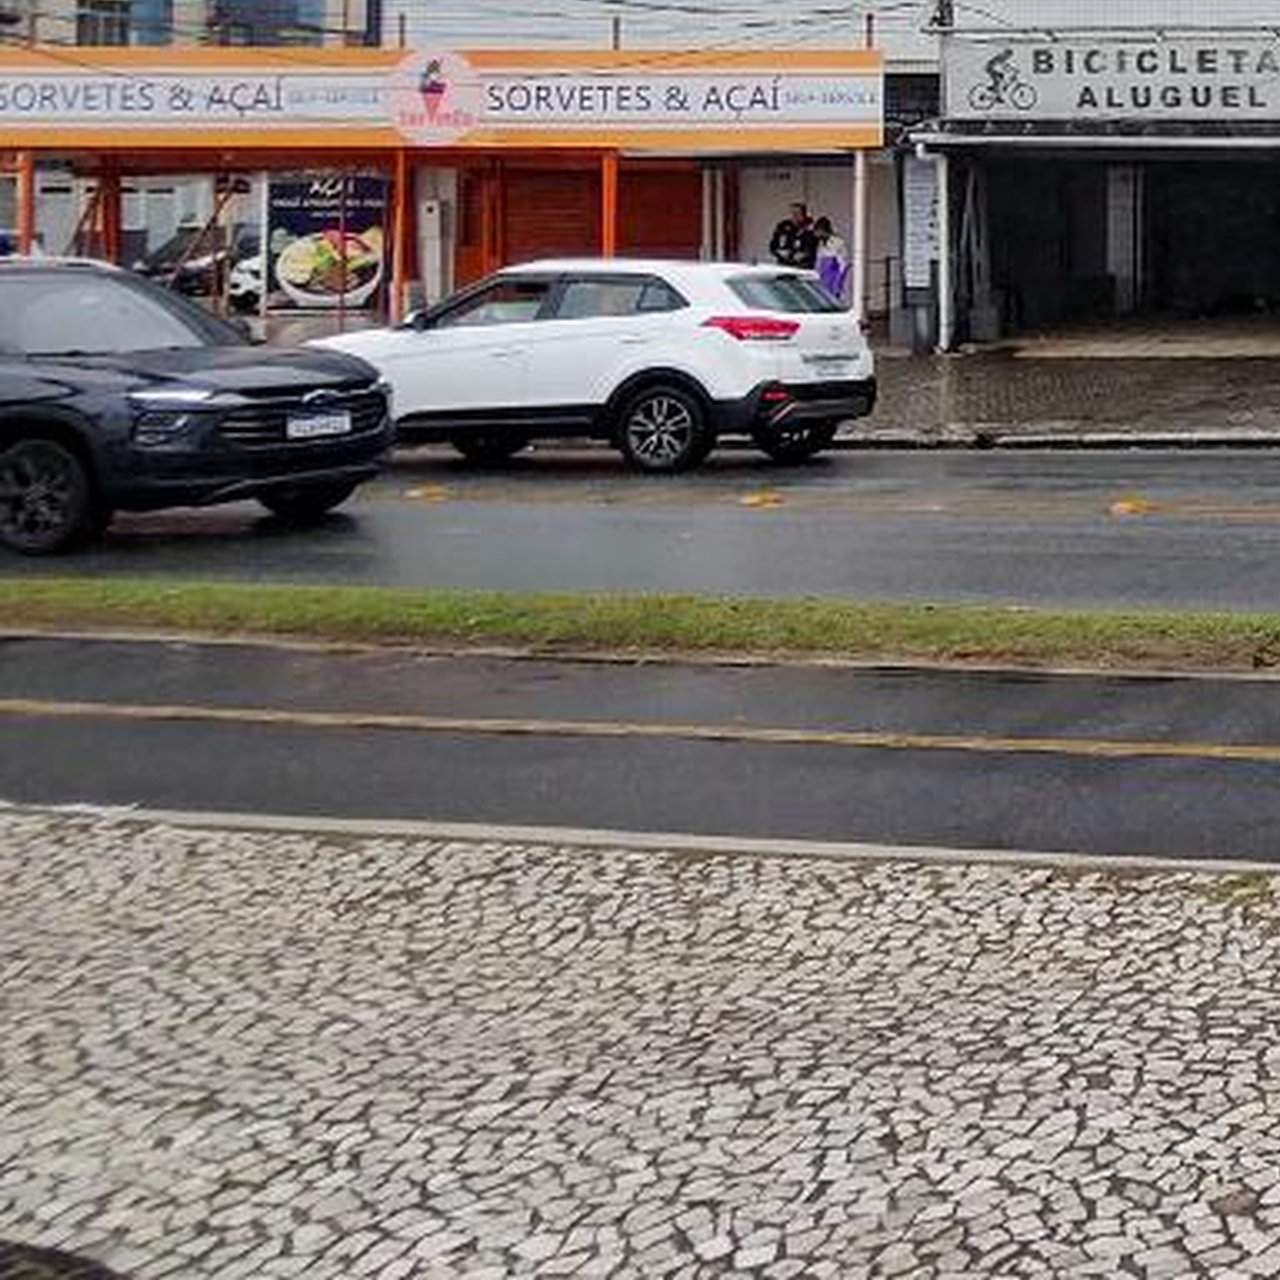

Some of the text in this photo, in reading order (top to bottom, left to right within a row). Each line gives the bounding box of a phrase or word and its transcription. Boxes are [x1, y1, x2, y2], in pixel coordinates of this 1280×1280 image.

[168, 83, 195, 111] &
[206, 74, 284, 118] AÇAÍ
[486, 84, 652, 112] SORVETES
[663, 84, 690, 112] &
[701, 75, 782, 120] AÇAÍ
[1076, 86, 1267, 109] ALUGUEL
